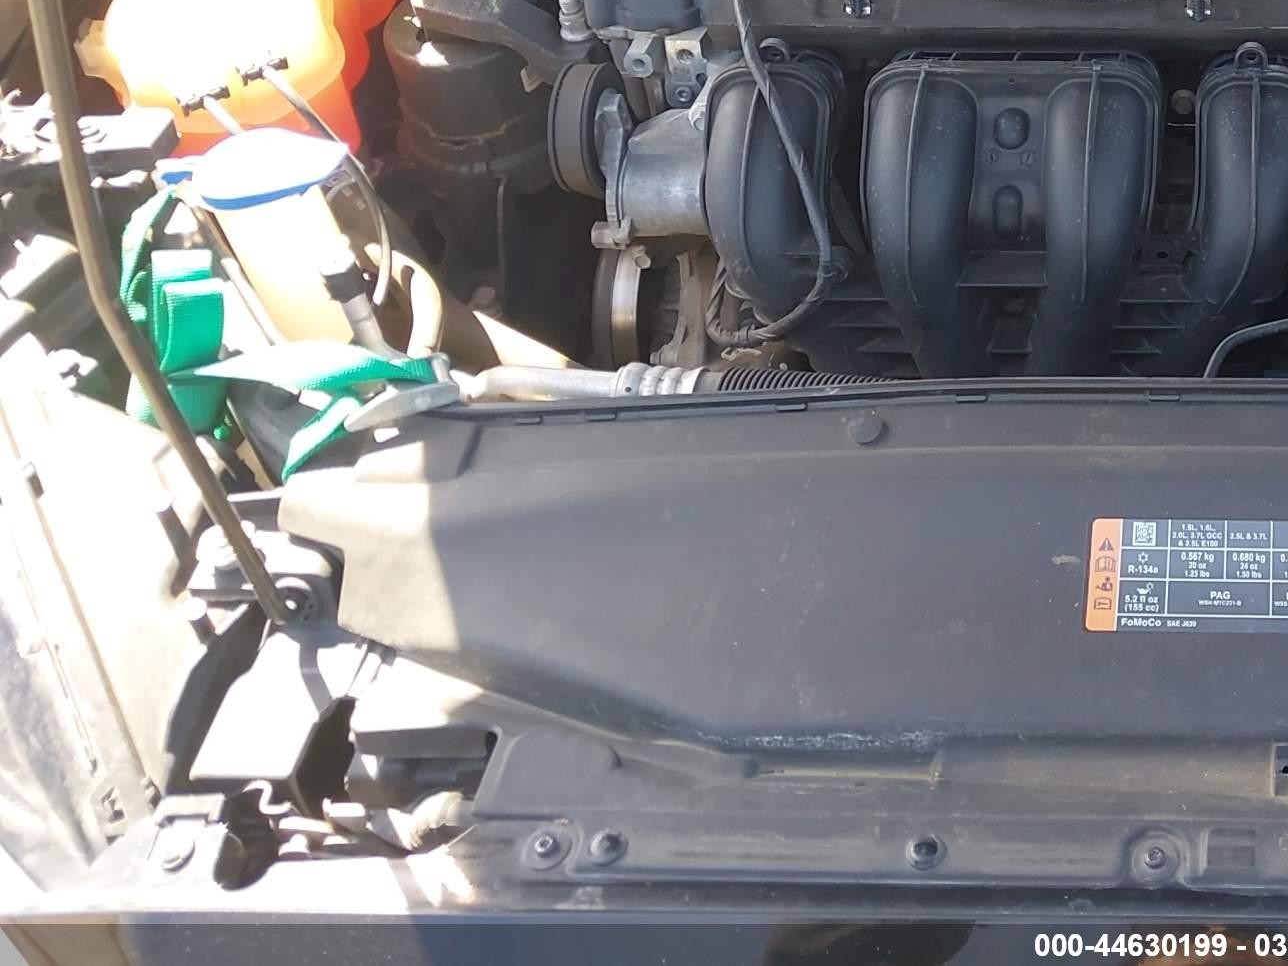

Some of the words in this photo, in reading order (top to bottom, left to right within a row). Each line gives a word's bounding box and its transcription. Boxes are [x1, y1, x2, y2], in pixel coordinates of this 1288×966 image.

[1181, 552, 1203, 561] 0.567
[1204, 552, 1215, 563] kg
[1232, 553, 1254, 562] 0.680
[1255, 553, 1266, 563] kg
[1127, 565, 1159, 574] R-134a
[1251, 571, 1262, 579] lbs
[1124, 595, 1138, 603] 5.2
[1139, 595, 1146, 603] fl
[1210, 591, 1231, 600] PAG
[1124, 603, 1143, 612] (155
[1145, 604, 1159, 613] cc)
[1120, 618, 1162, 627] FoMoCo
[1182, 620, 1197, 628] J639
